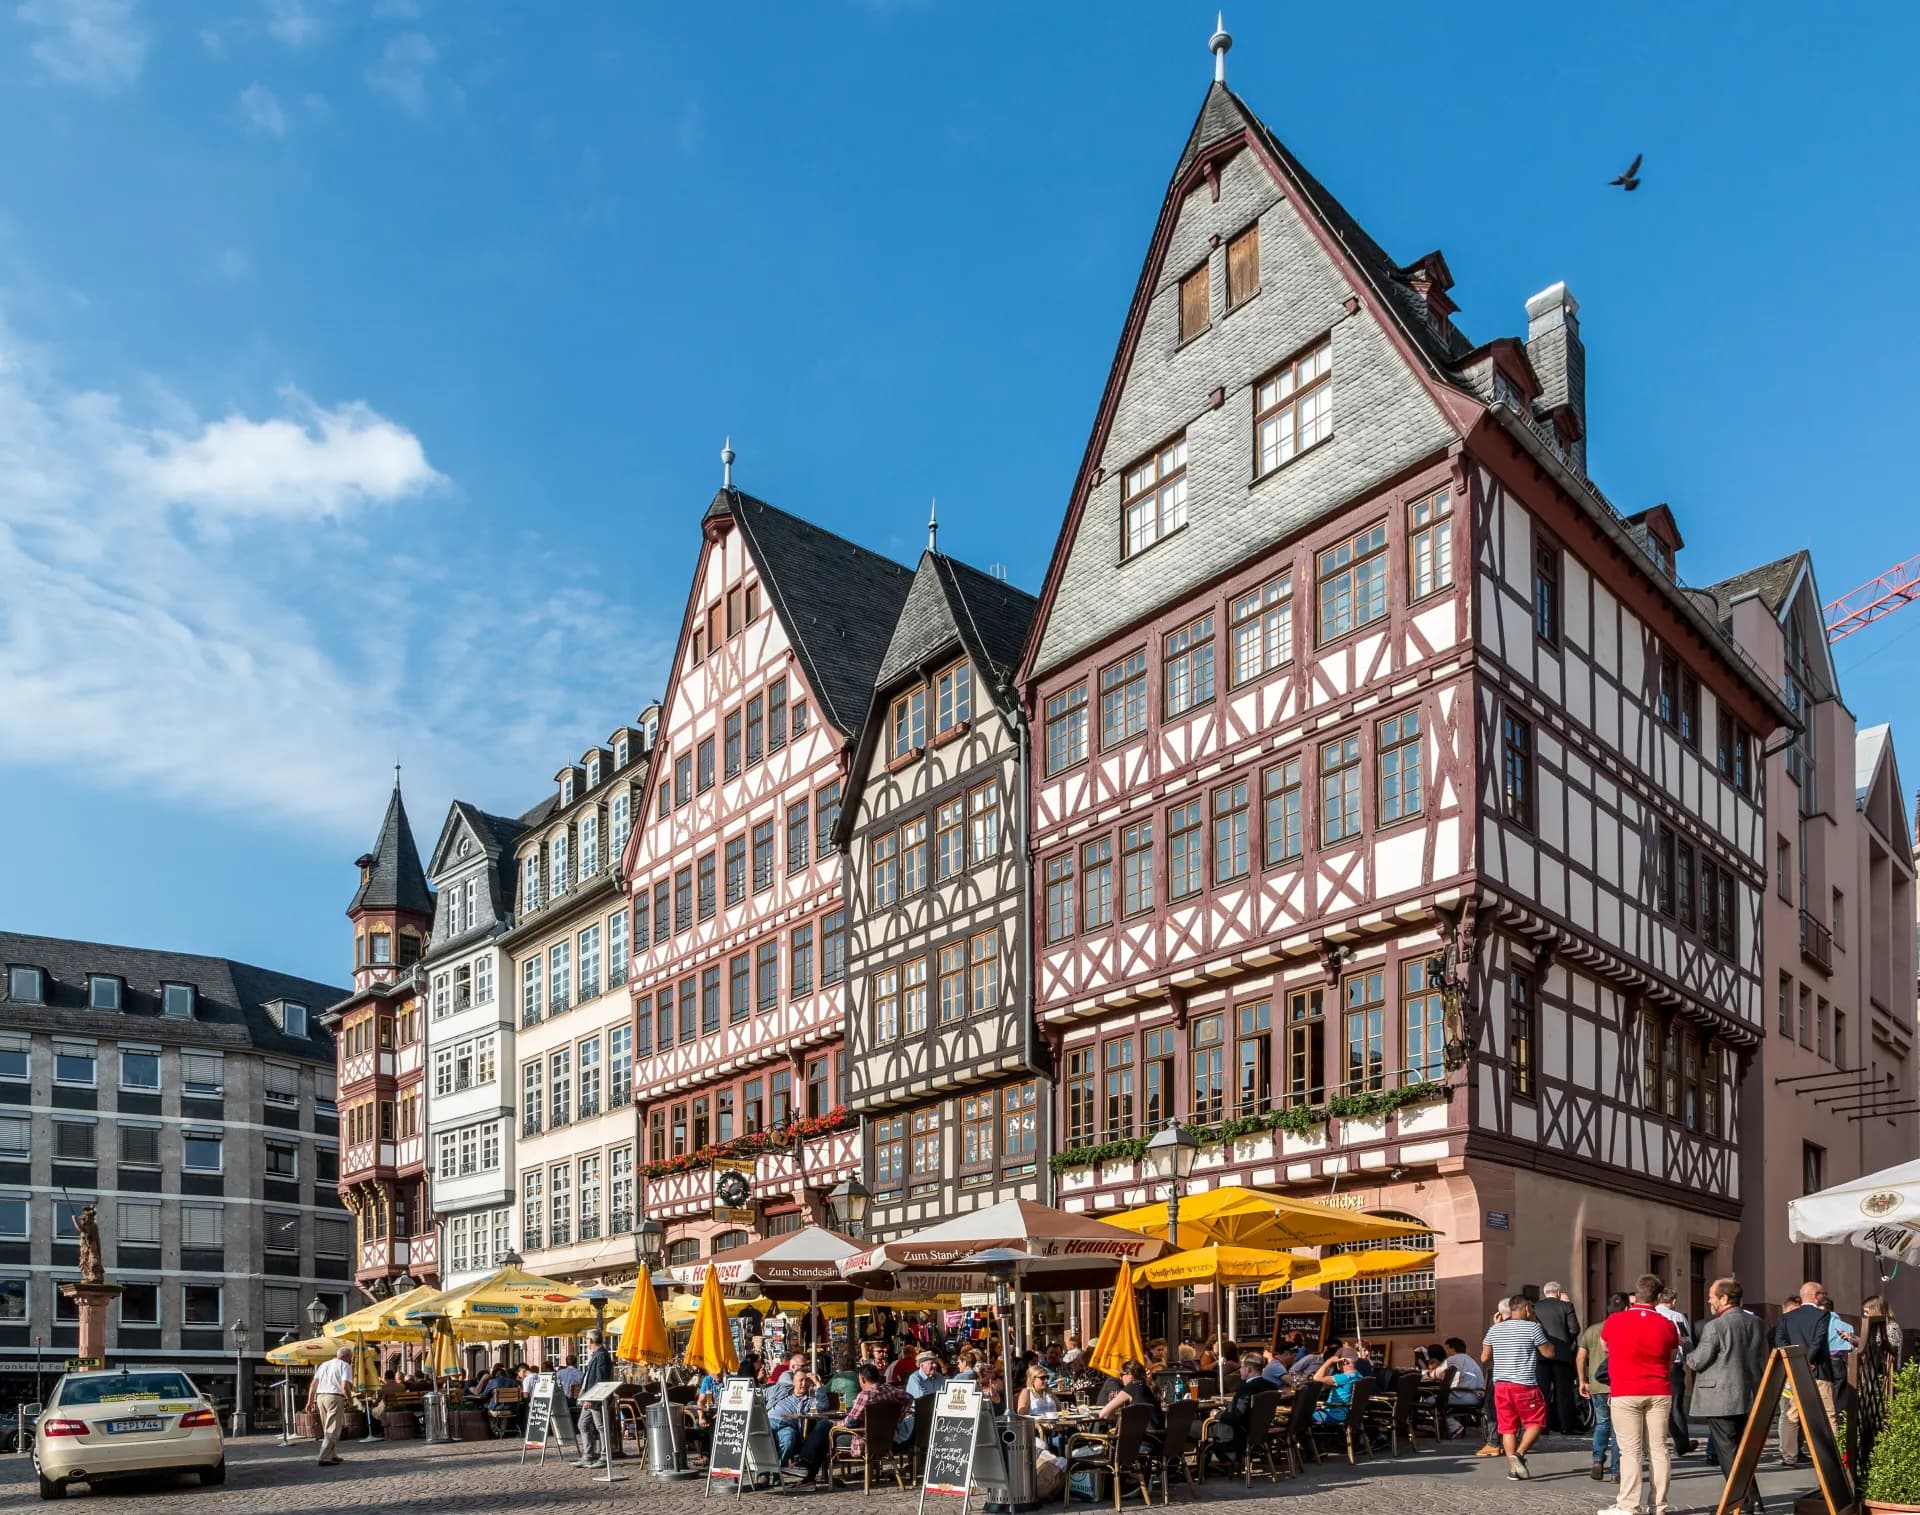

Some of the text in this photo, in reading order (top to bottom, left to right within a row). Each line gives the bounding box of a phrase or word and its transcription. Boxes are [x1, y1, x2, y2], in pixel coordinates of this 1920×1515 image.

[1063, 1240, 1144, 1258] Henninger
[903, 1251, 929, 1262] Zum
[768, 1266, 790, 1276] Zum
